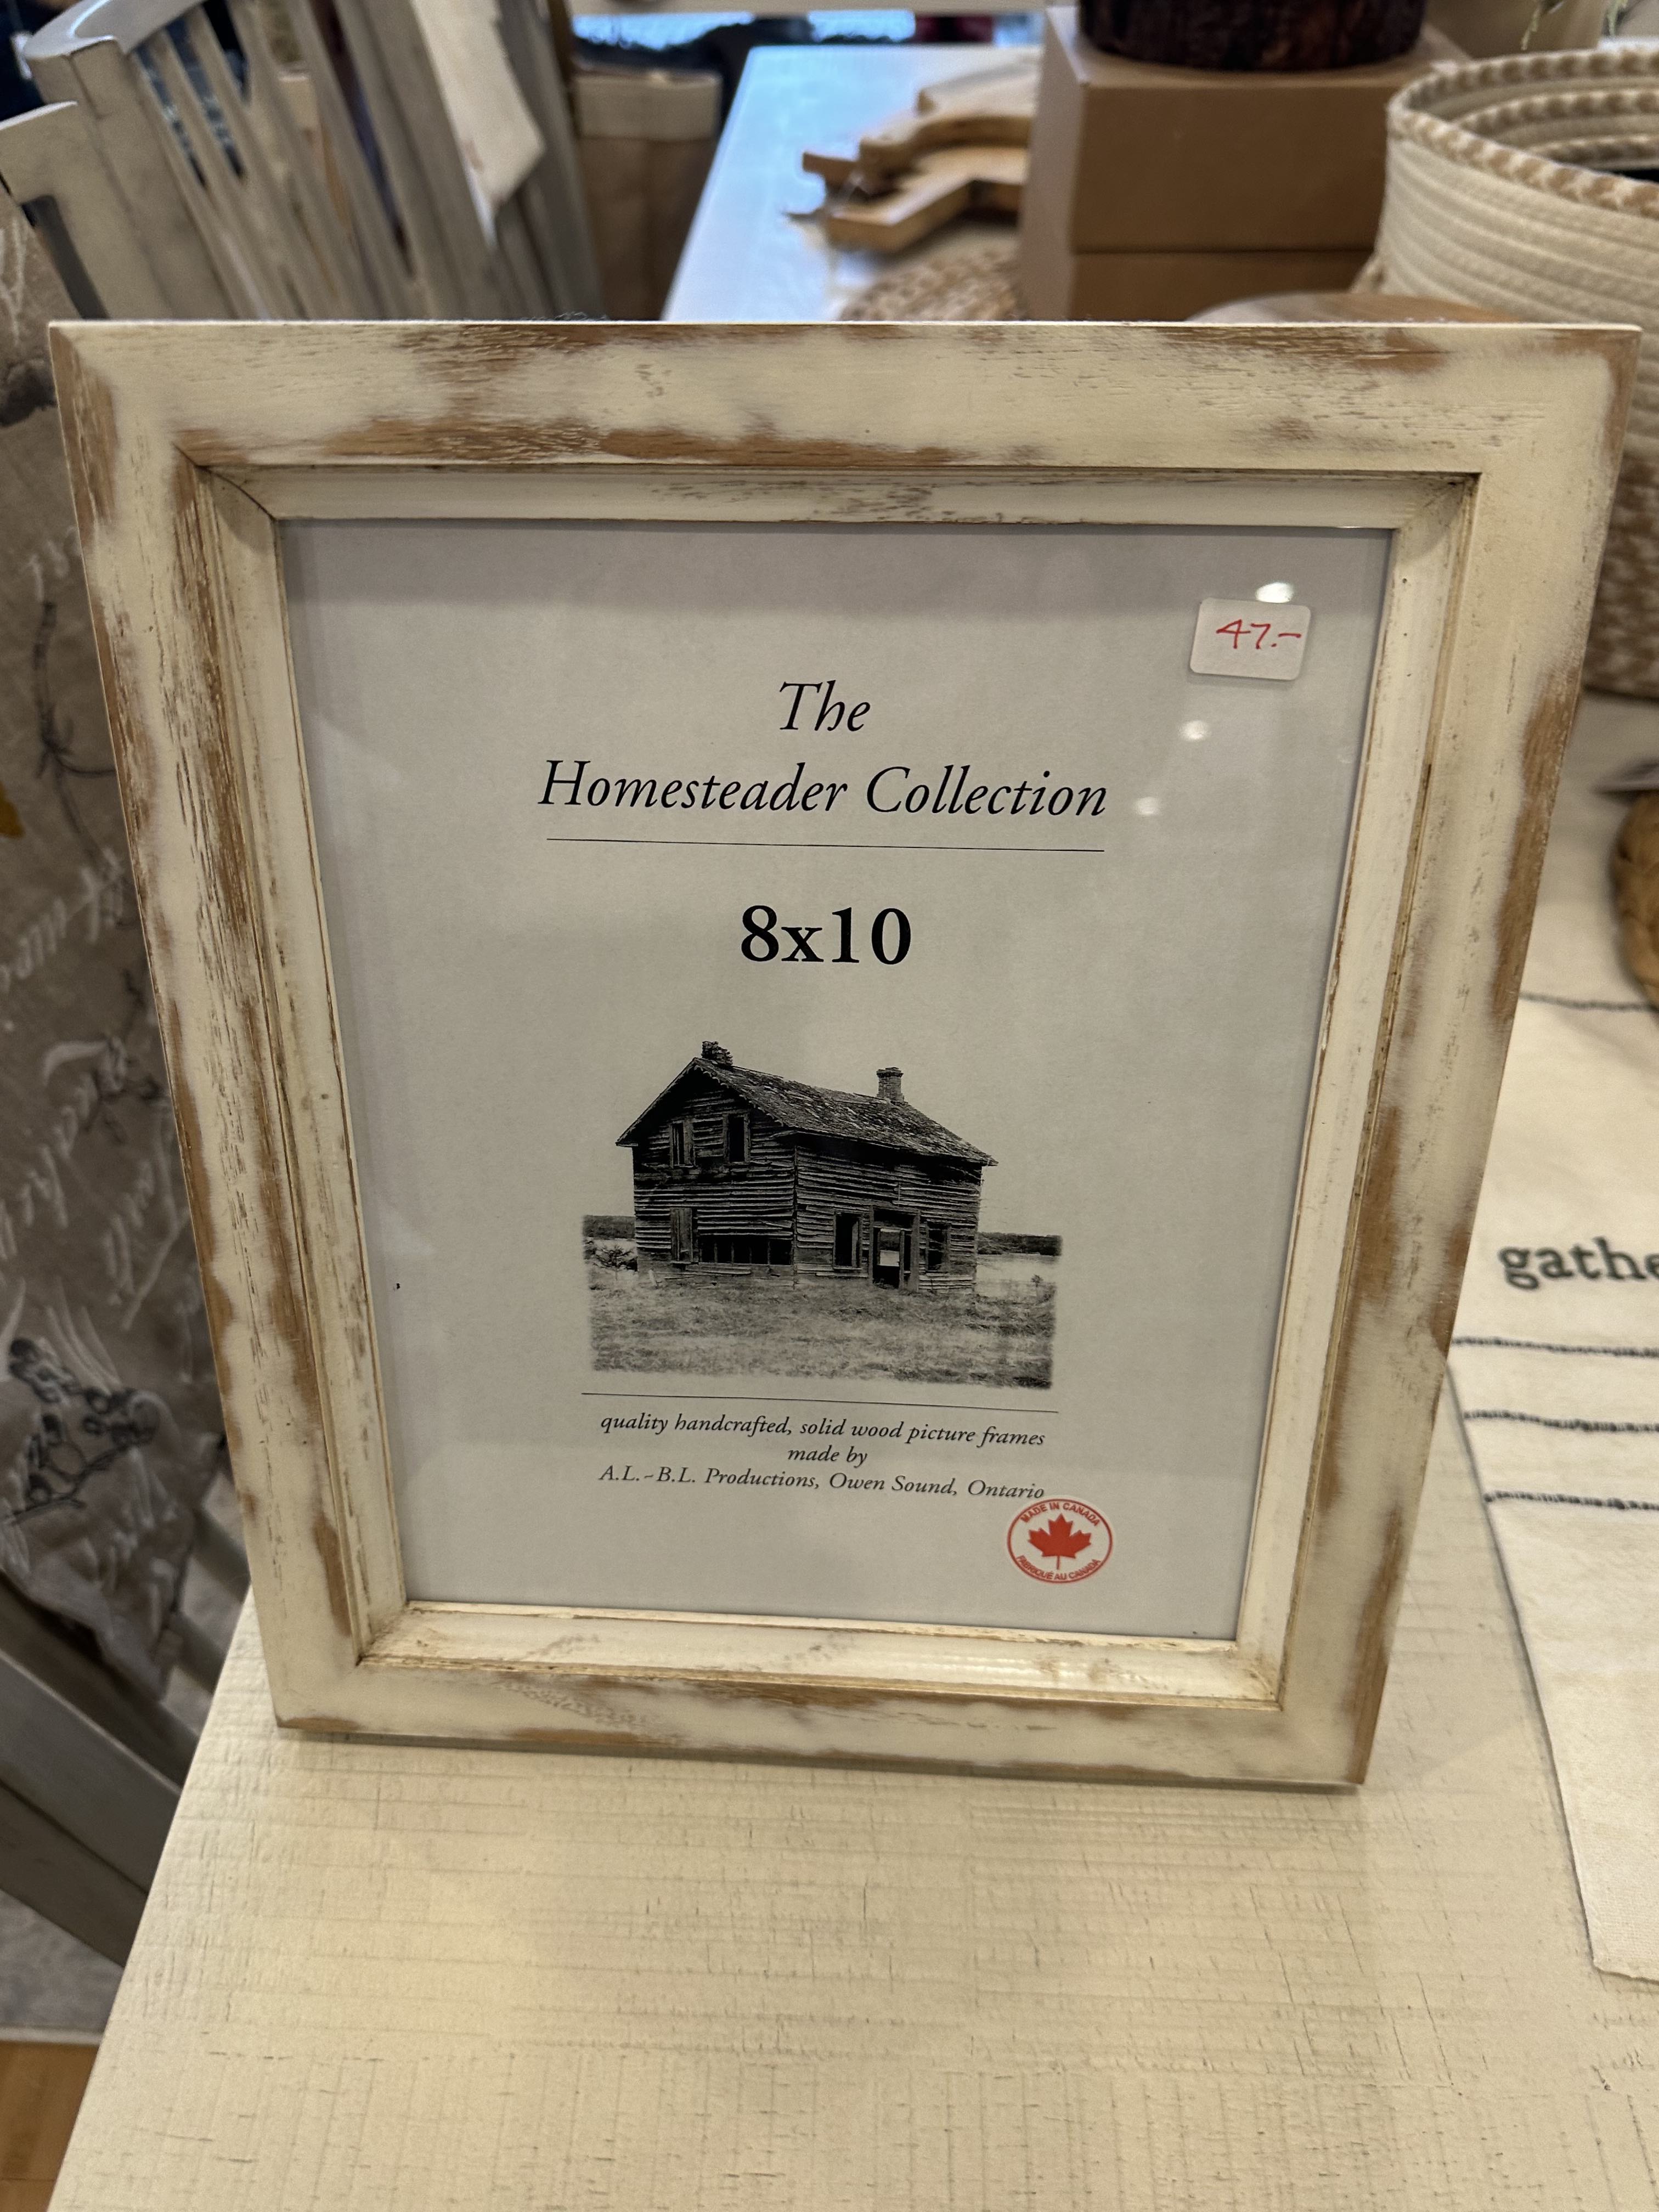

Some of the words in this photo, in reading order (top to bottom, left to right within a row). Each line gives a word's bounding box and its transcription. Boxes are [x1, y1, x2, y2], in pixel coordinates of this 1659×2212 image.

[779, 679, 871, 732] The
[537, 759, 848, 811] Homesteader
[866, 764, 1107, 816] Collection
[741, 905, 911, 965] 8x10
[600, 1412, 669, 1436] quality
[674, 1413, 792, 1438] handcrafted,
[799, 1417, 848, 1436] solid
[851, 1421, 905, 1438] wood
[904, 1424, 976, 1444] picture
[976, 1425, 1045, 1448] frames
[787, 1444, 840, 1462] made
[846, 1445, 868, 1469] by
[704, 1468, 819, 1489] Productions,
[829, 1472, 885, 1490] Owen
[891, 1475, 957, 1496] Sound,
[968, 1480, 1045, 1499] Ontario
[1020, 1504, 1047, 1522] MADE
[1049, 1502, 1059, 1510] IN
[1063, 1503, 1100, 1526] CANADA
